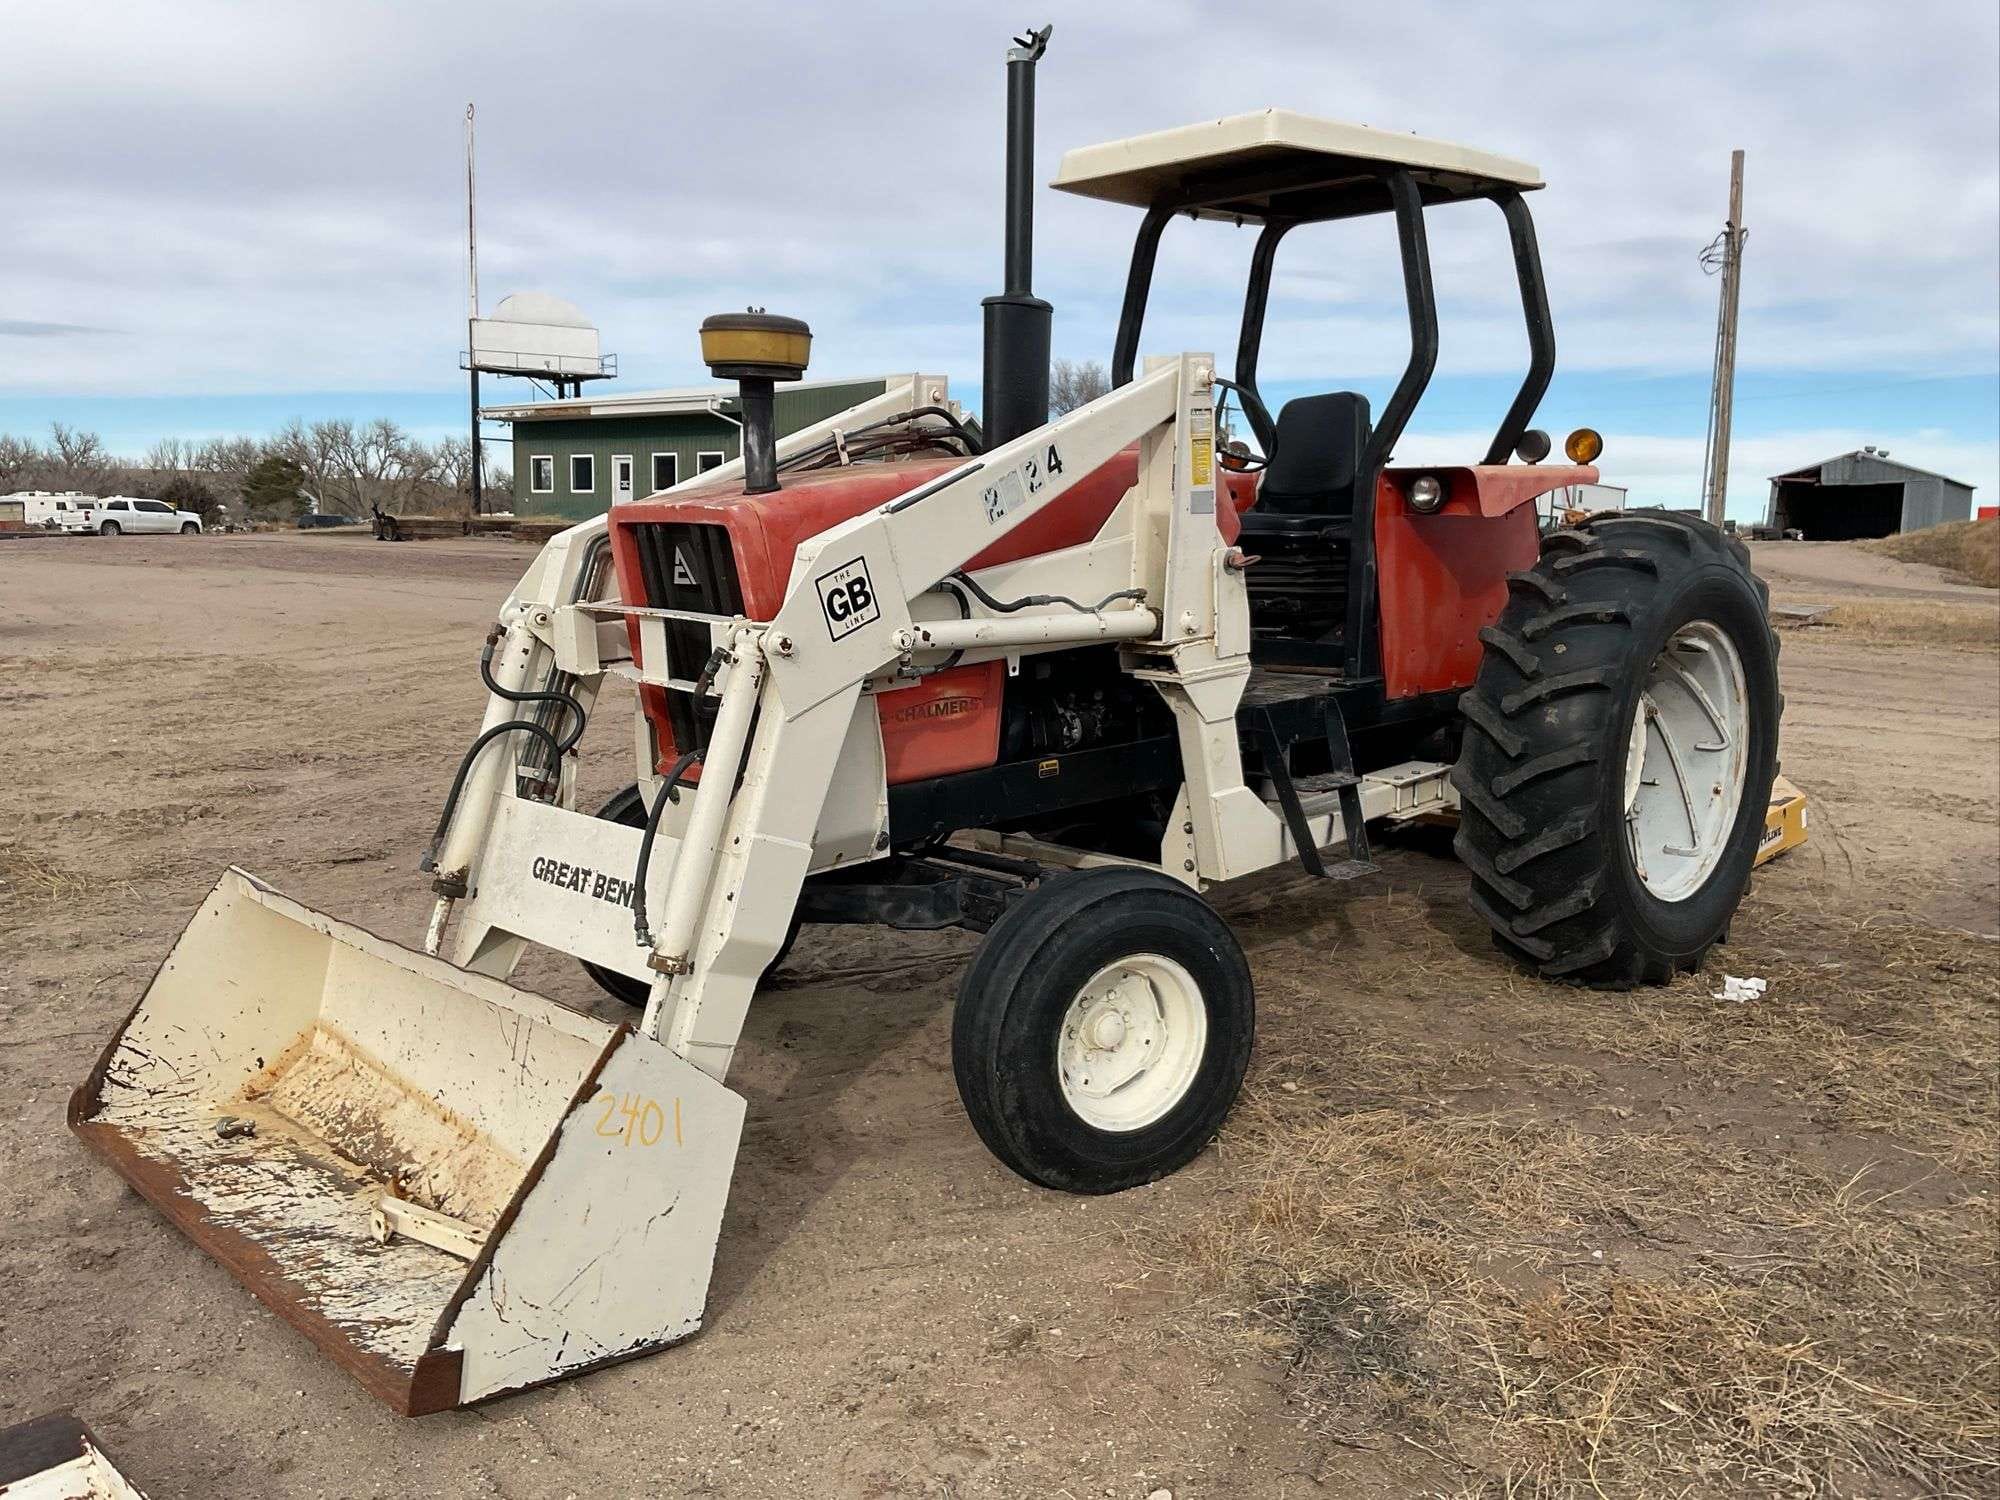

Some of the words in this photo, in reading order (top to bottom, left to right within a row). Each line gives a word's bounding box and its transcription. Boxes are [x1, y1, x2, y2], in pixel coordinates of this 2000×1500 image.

[826, 576, 872, 622] GB
[834, 569, 851, 583] THE
[844, 613, 865, 629] LINE
[532, 856, 592, 893] GREAT
[591, 873, 636, 910] BEN
[594, 1091, 683, 1148] 2401
